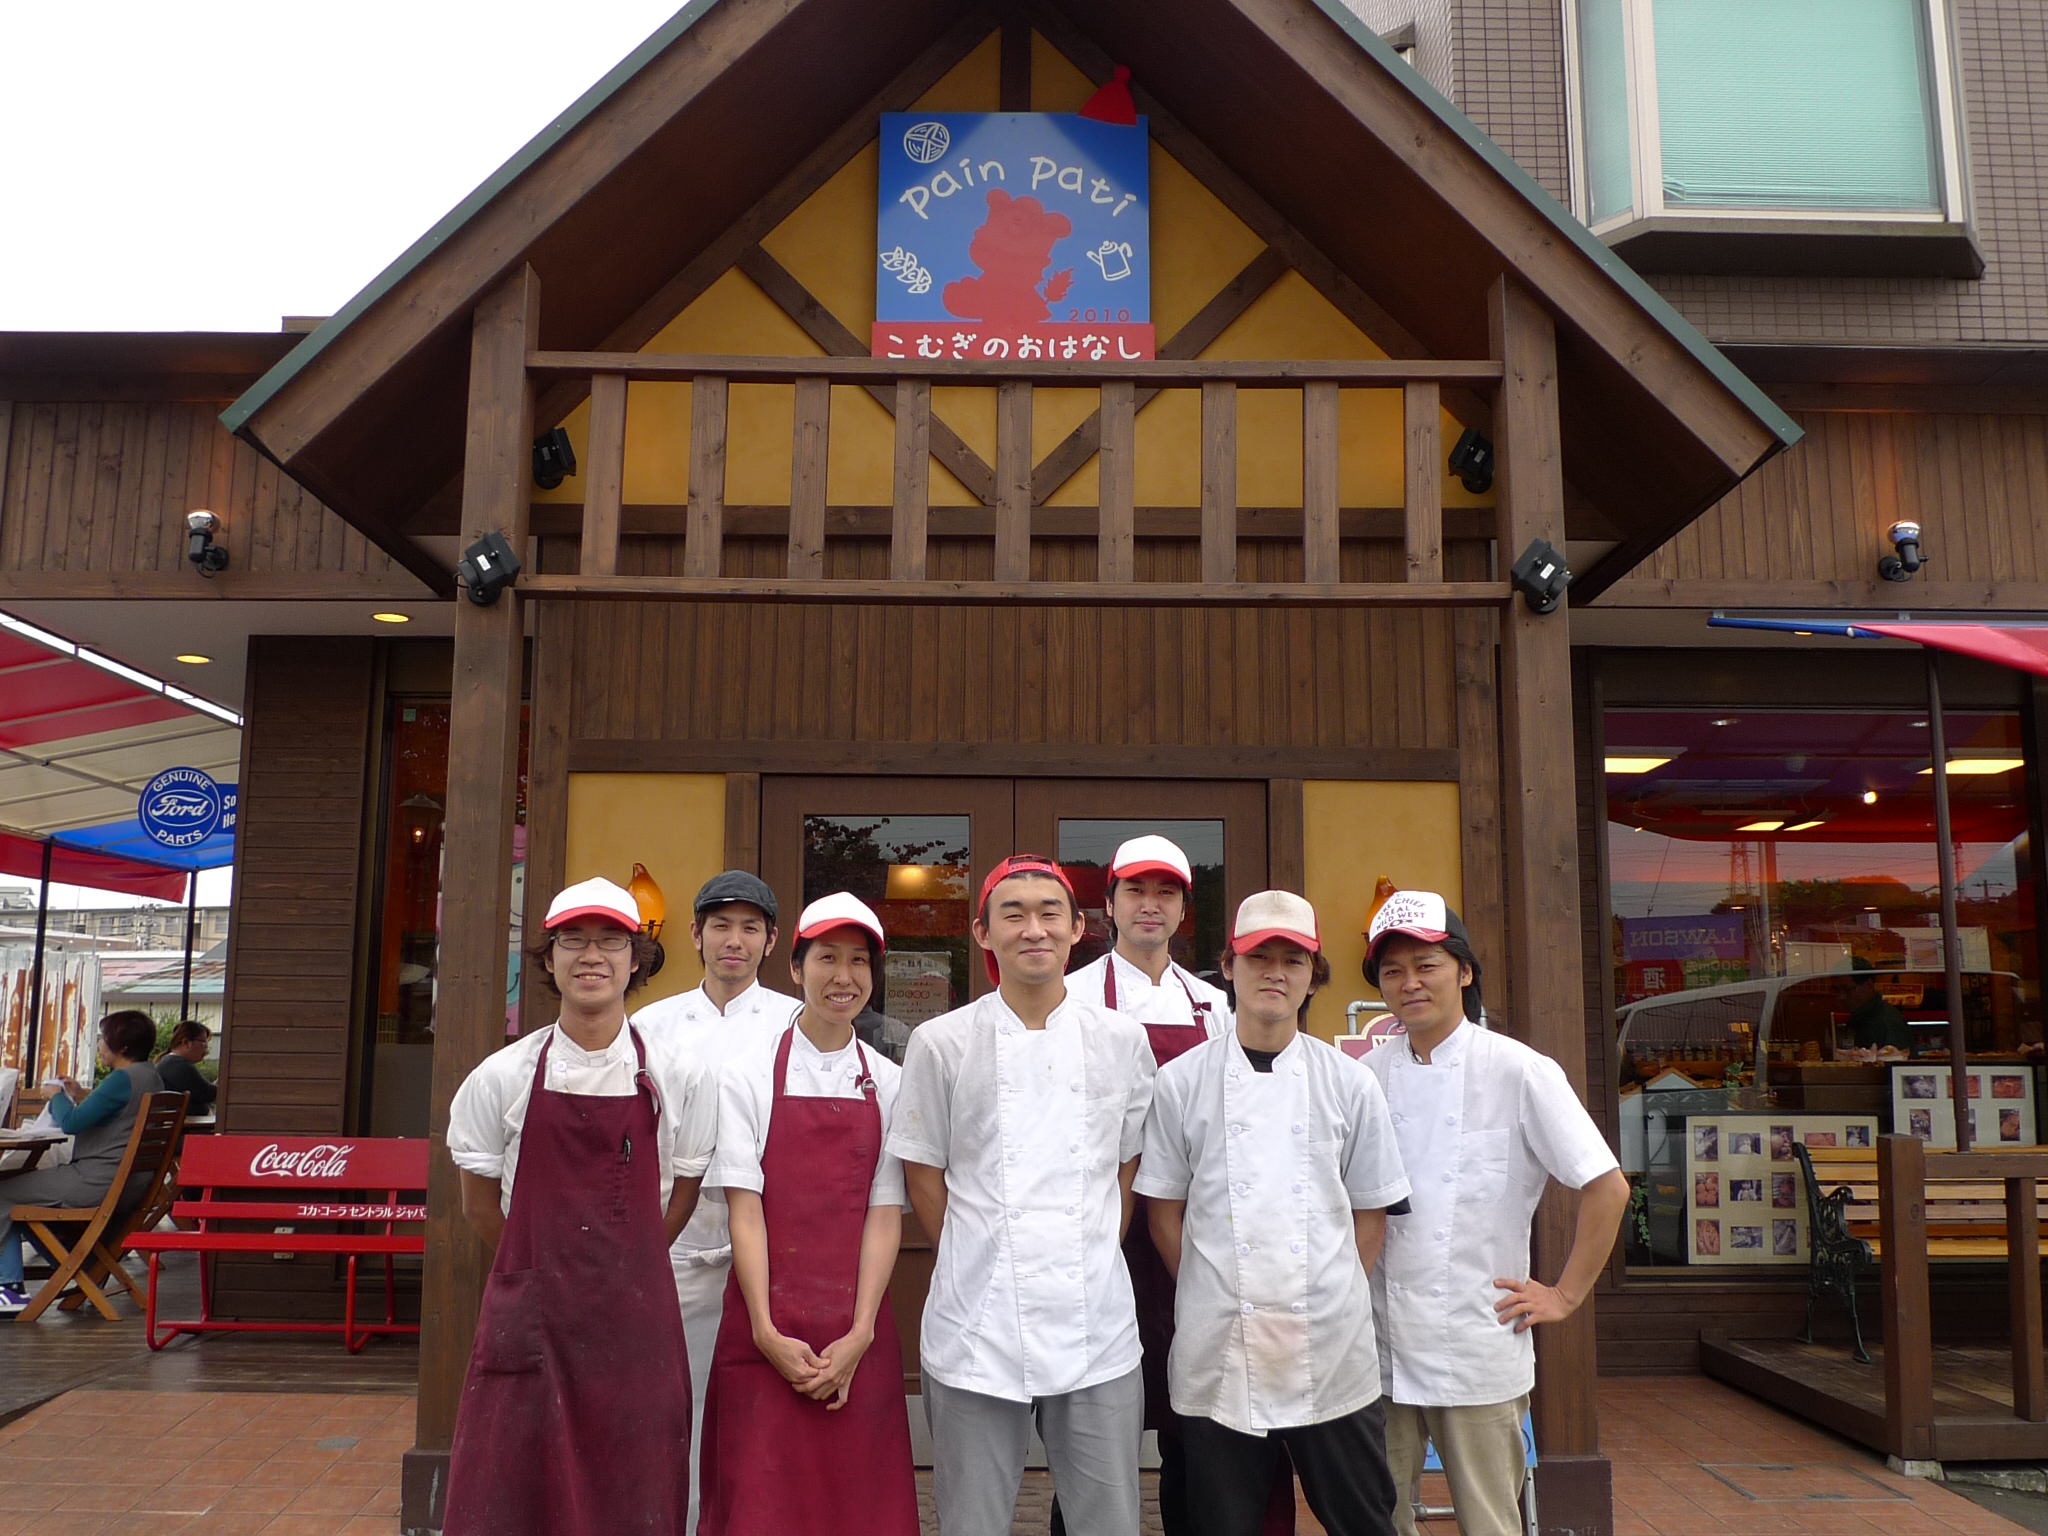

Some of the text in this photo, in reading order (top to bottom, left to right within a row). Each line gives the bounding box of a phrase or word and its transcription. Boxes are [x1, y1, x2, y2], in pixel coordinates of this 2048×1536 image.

[899, 156, 1137, 219] Pain Pati
[1069, 309, 1130, 322] 2010
[887, 332, 1141, 361] こむぎのおはなし
[153, 771, 210, 792] GENUINE
[151, 794, 209, 817] Ford
[156, 829, 204, 845] PARTS
[1384, 905, 1410, 918] REAL
[1397, 911, 1425, 919] WEST
[250, 1143, 356, 1178] Coca-Cola
[350, 1205, 393, 1218] セントラル
